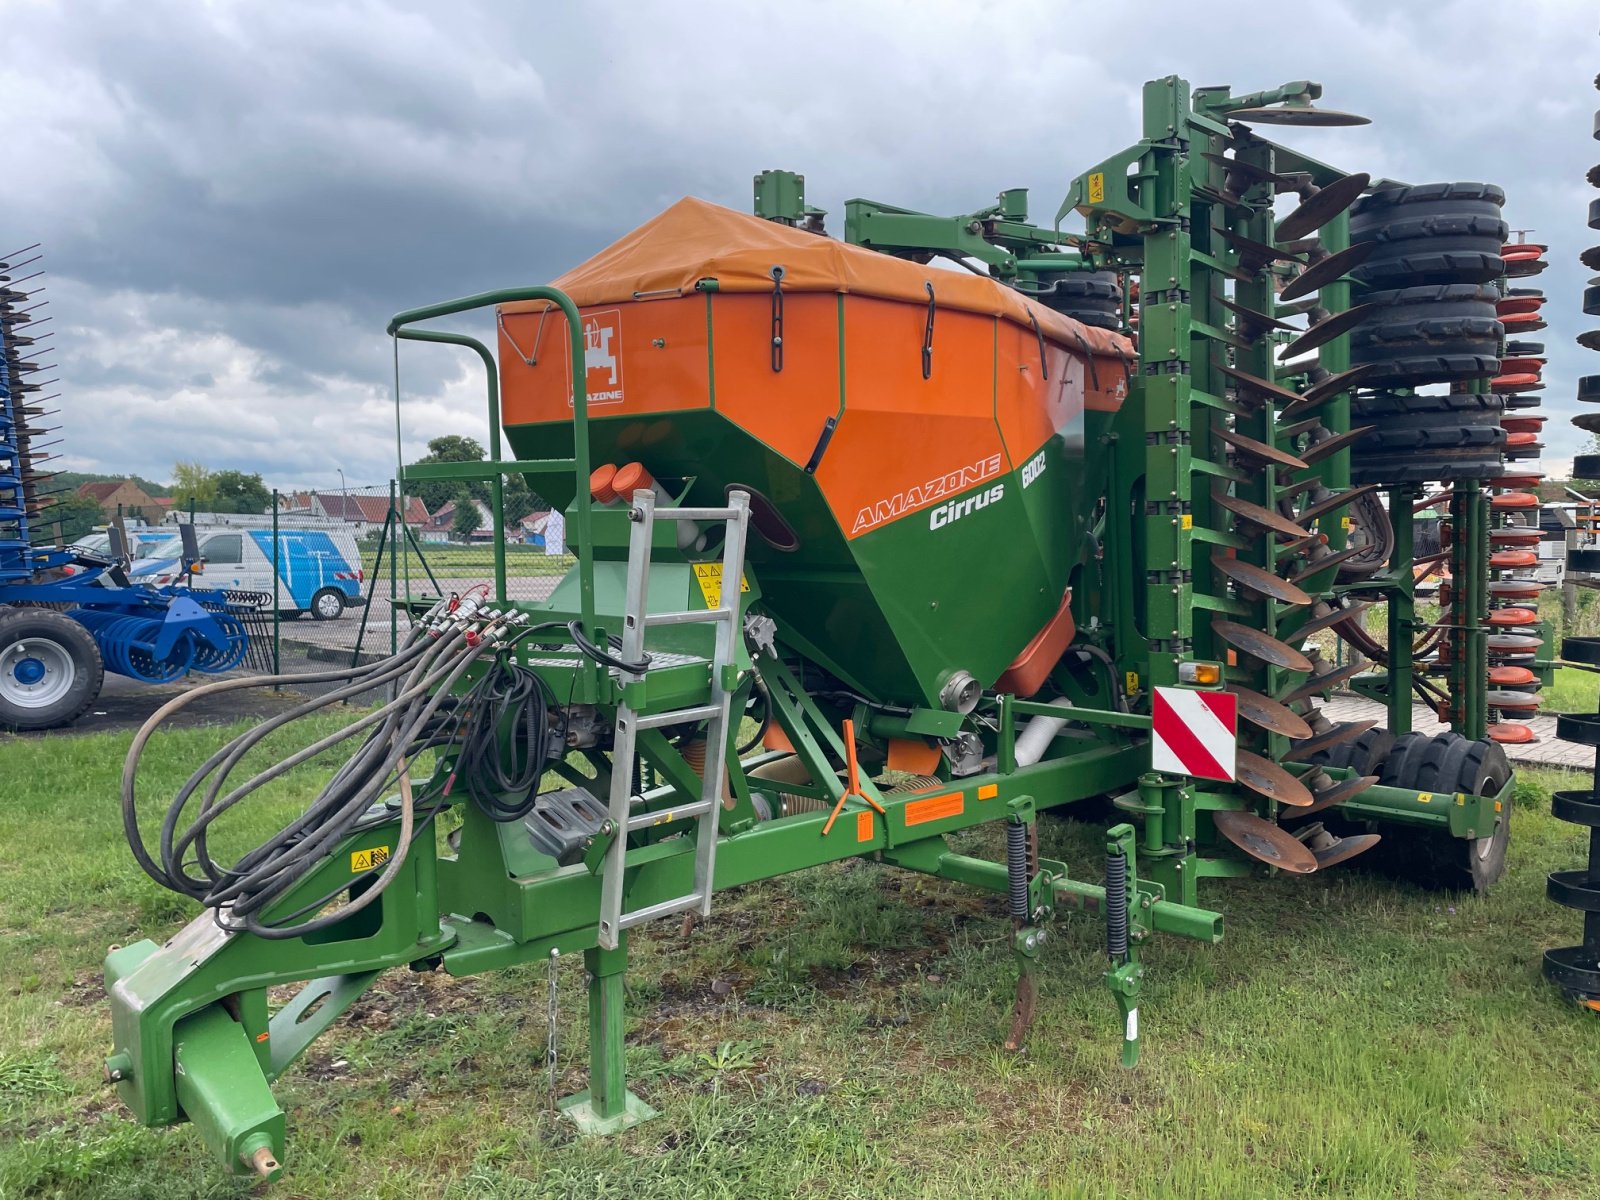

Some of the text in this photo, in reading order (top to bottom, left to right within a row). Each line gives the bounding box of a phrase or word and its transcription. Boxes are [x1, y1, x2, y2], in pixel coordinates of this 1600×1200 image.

[569, 390, 622, 404] AAZONE
[851, 452, 1002, 534] AMAZONE
[929, 449, 1046, 531] Cirrus 6002
